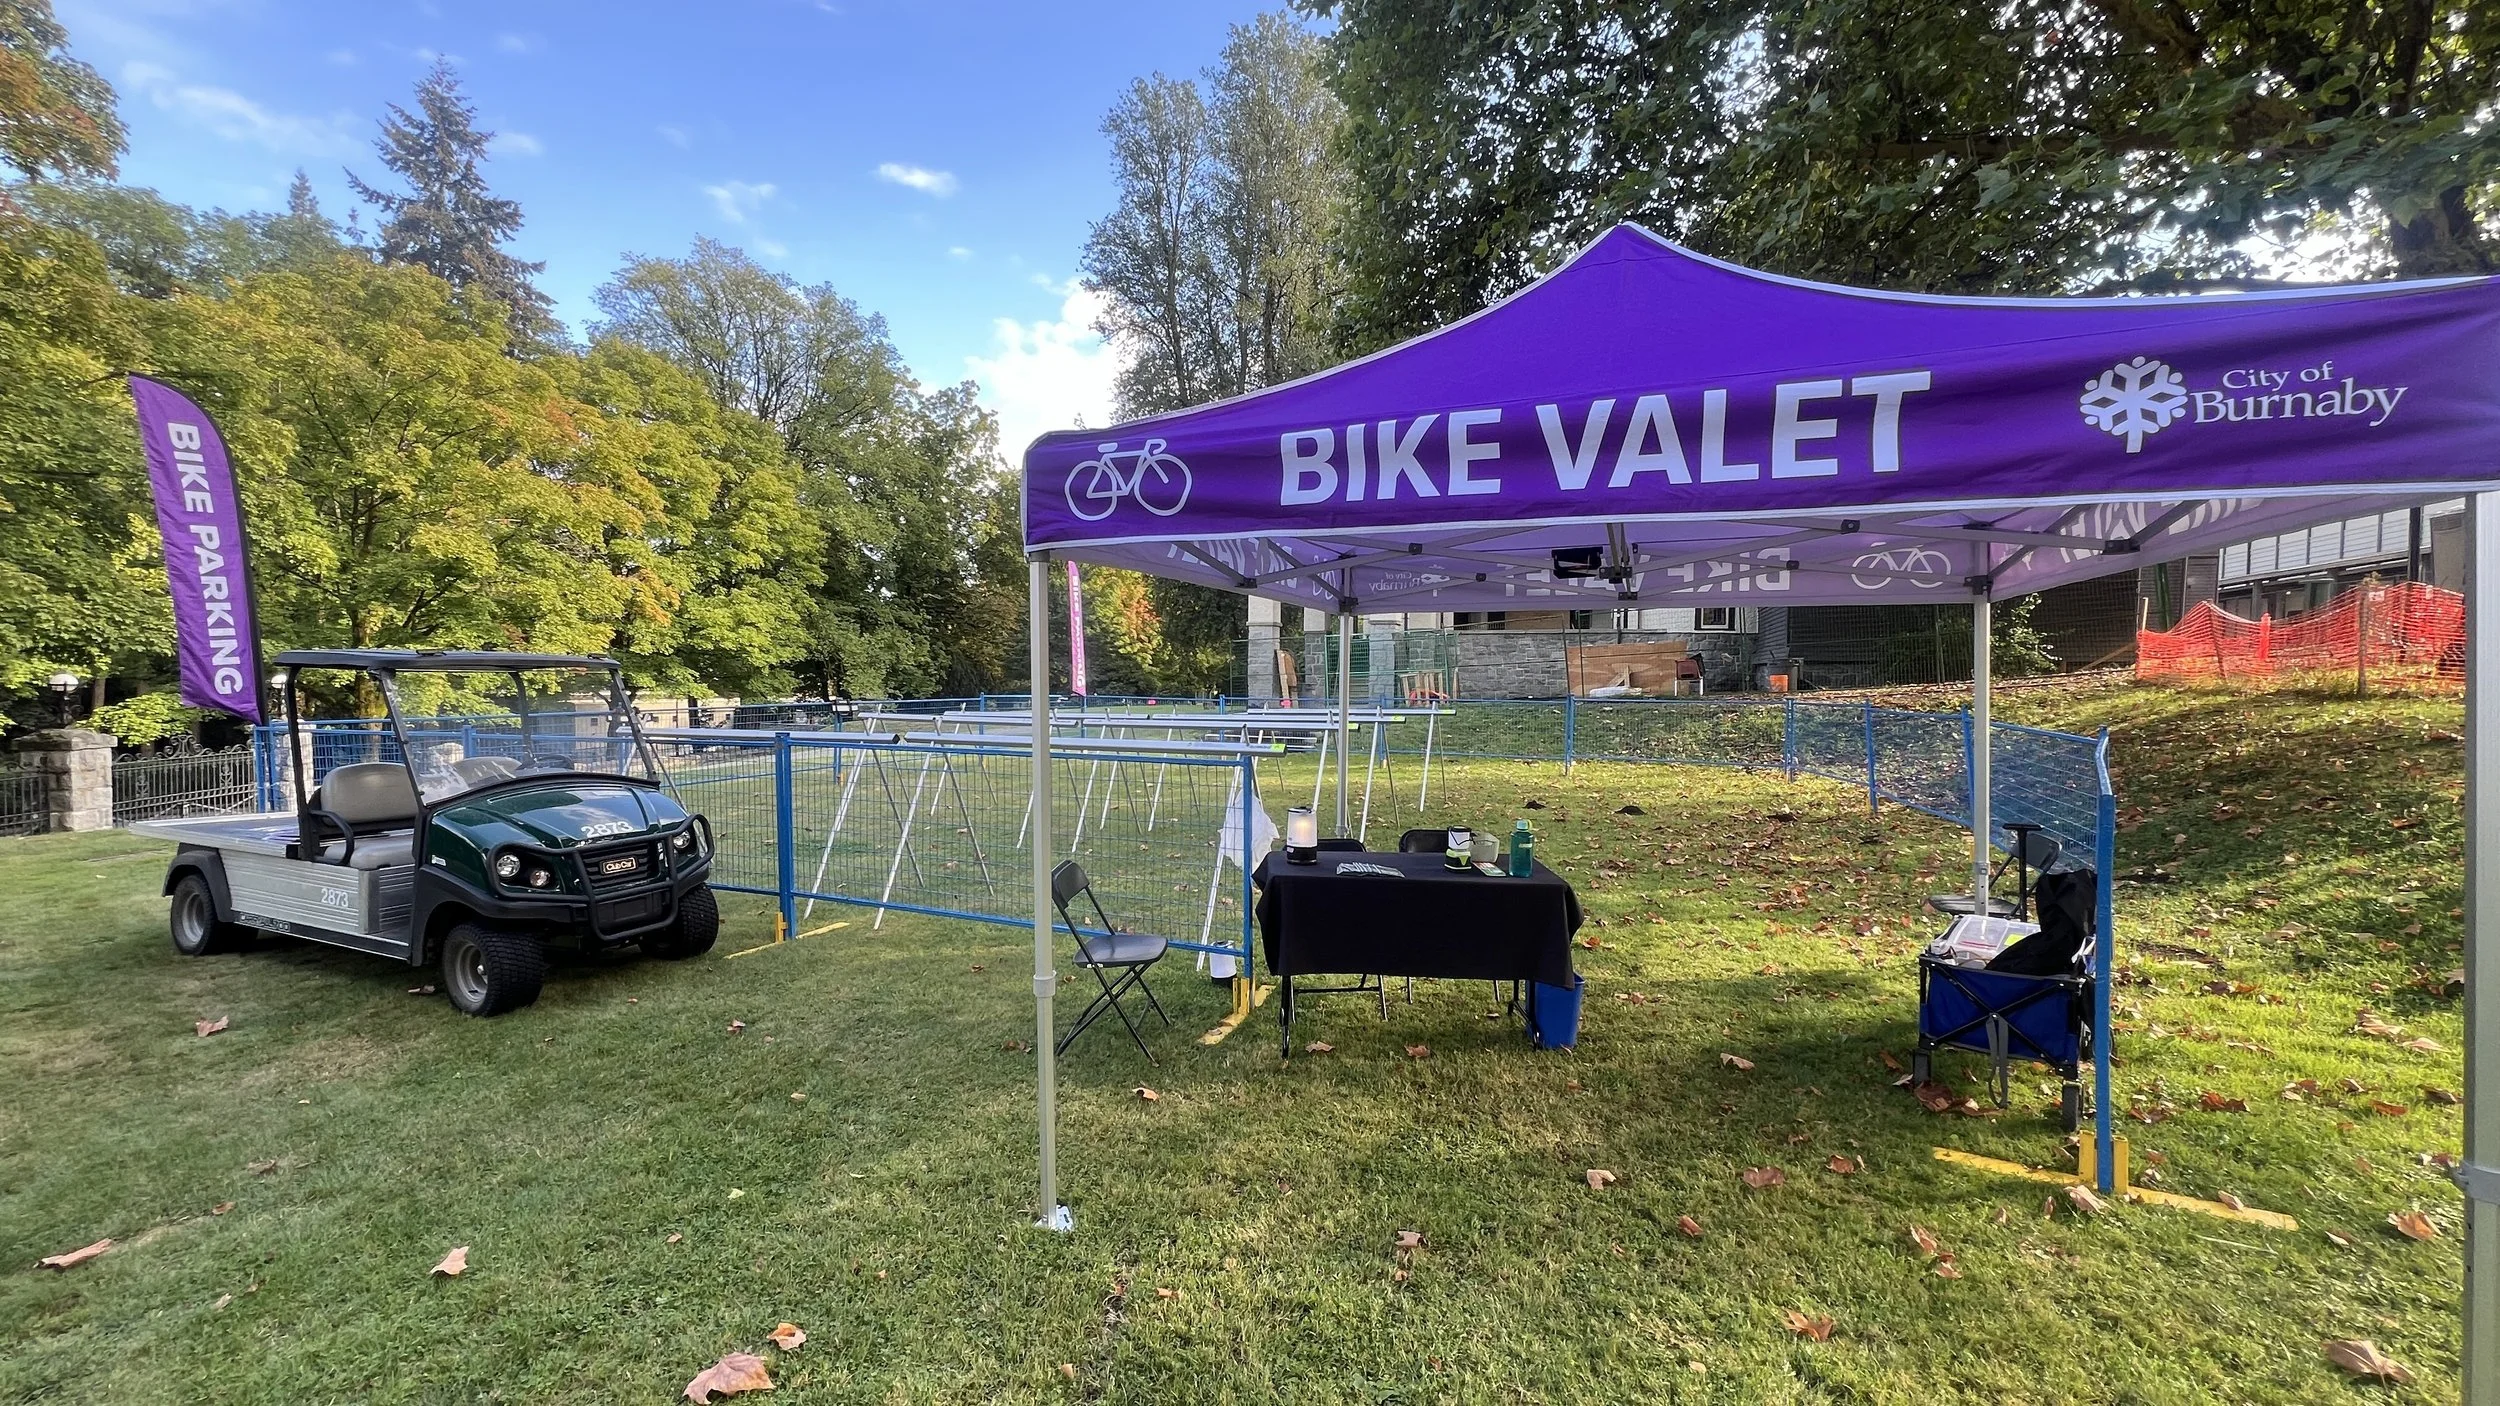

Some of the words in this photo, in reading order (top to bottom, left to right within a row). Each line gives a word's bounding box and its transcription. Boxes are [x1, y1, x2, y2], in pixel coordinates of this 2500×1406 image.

[2222, 369, 2291, 391] City
[2299, 360, 2334, 382] of
[2189, 377, 2409, 428] Burnaby
[1280, 407, 1502, 506] BIKE
[1535, 370, 1932, 491] VALET
[167, 421, 215, 514] BIKE
[189, 524, 244, 696] PARKING
[581, 821, 634, 838] 2873
[321, 887, 349, 908] 2873
